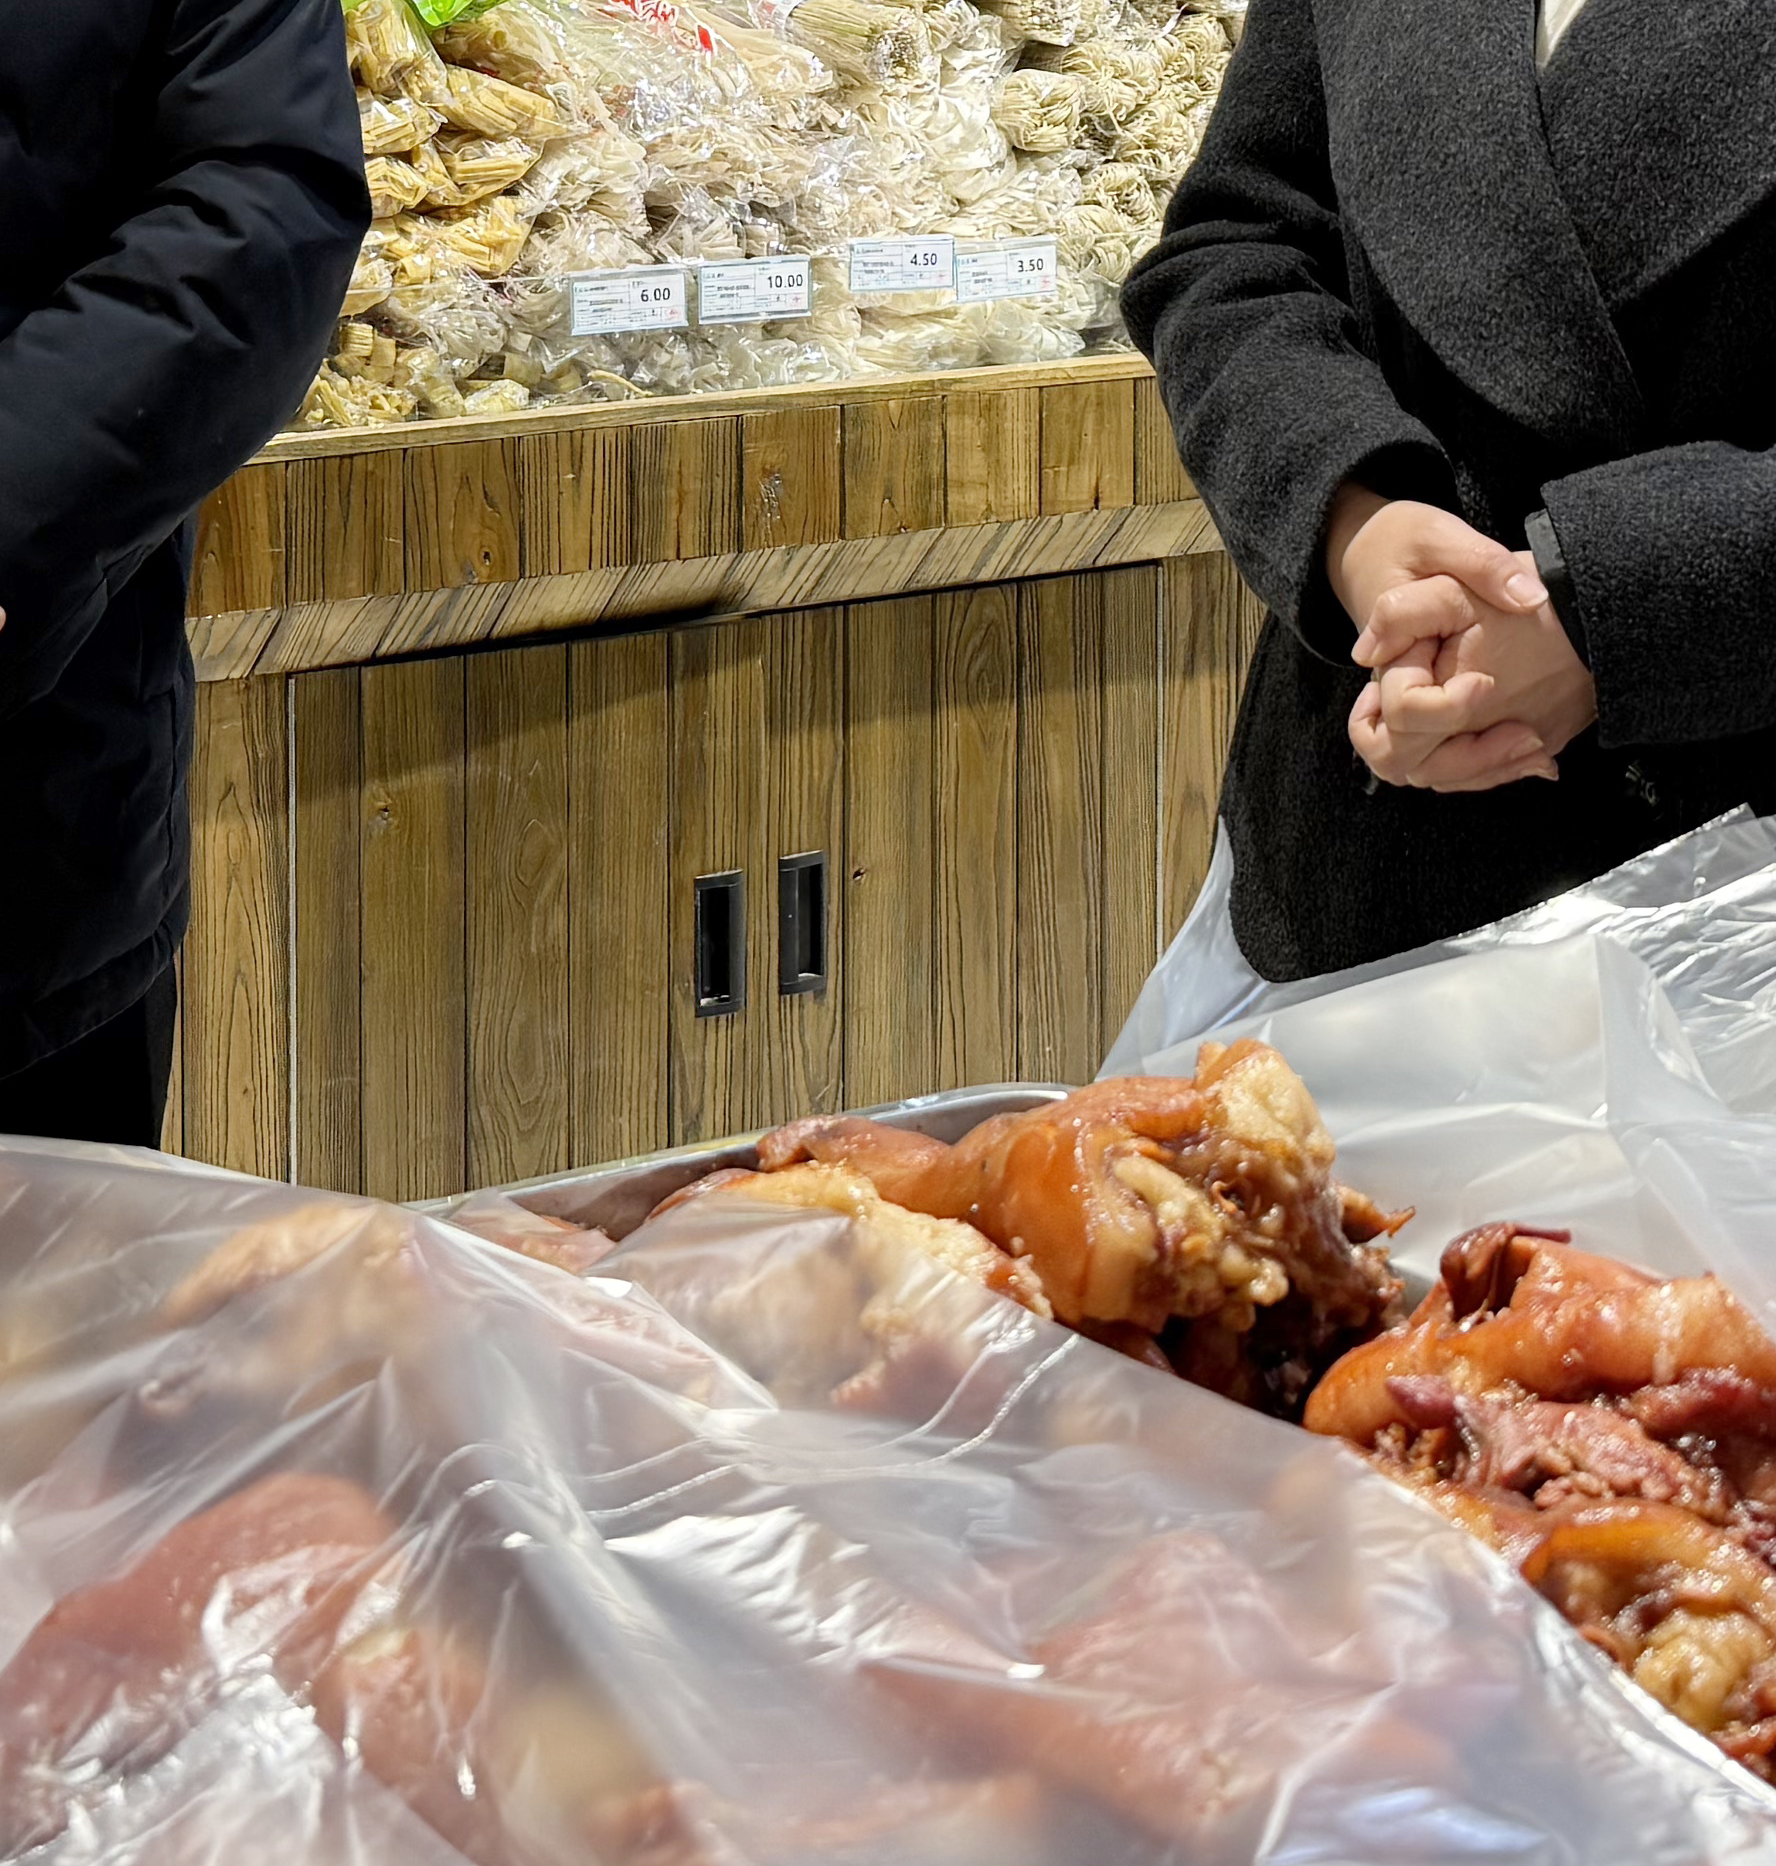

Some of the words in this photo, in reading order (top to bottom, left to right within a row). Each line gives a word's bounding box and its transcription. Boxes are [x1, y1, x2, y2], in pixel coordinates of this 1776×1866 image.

[910, 252, 938, 267] 4.50
[1017, 258, 1044, 273] 3.50
[767, 274, 804, 289] 10.00
[640, 287, 672, 303] 6.00
